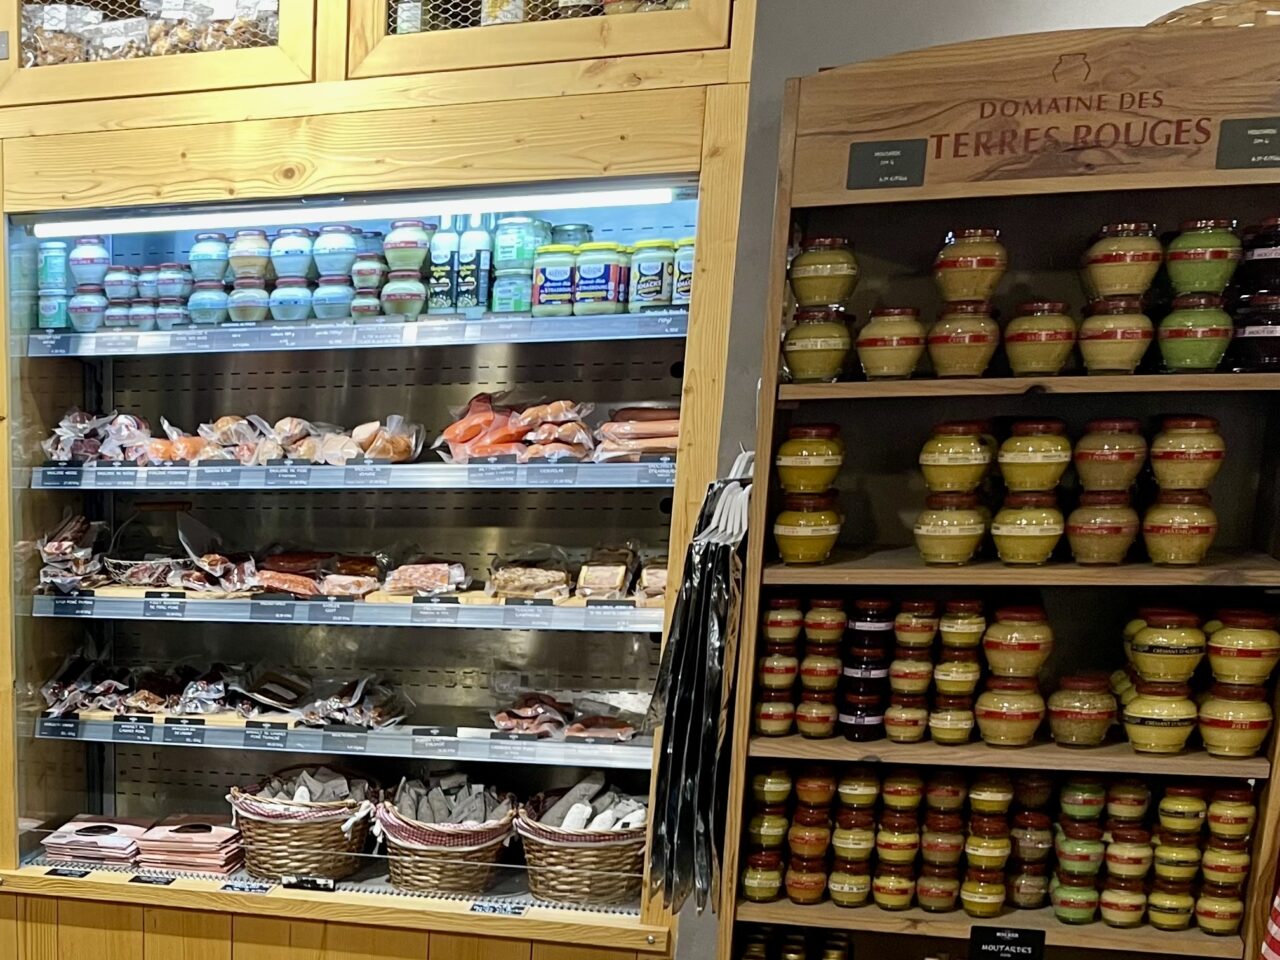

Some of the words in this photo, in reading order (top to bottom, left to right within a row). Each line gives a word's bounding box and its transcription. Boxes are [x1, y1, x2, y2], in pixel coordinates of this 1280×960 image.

[980, 94, 1108, 119] DOMAINE
[1120, 90, 1164, 110] DES
[929, 126, 1060, 160] TERRES
[1073, 117, 1213, 149] ROUGES
[981, 944, 1032, 954] MOUTARDES
